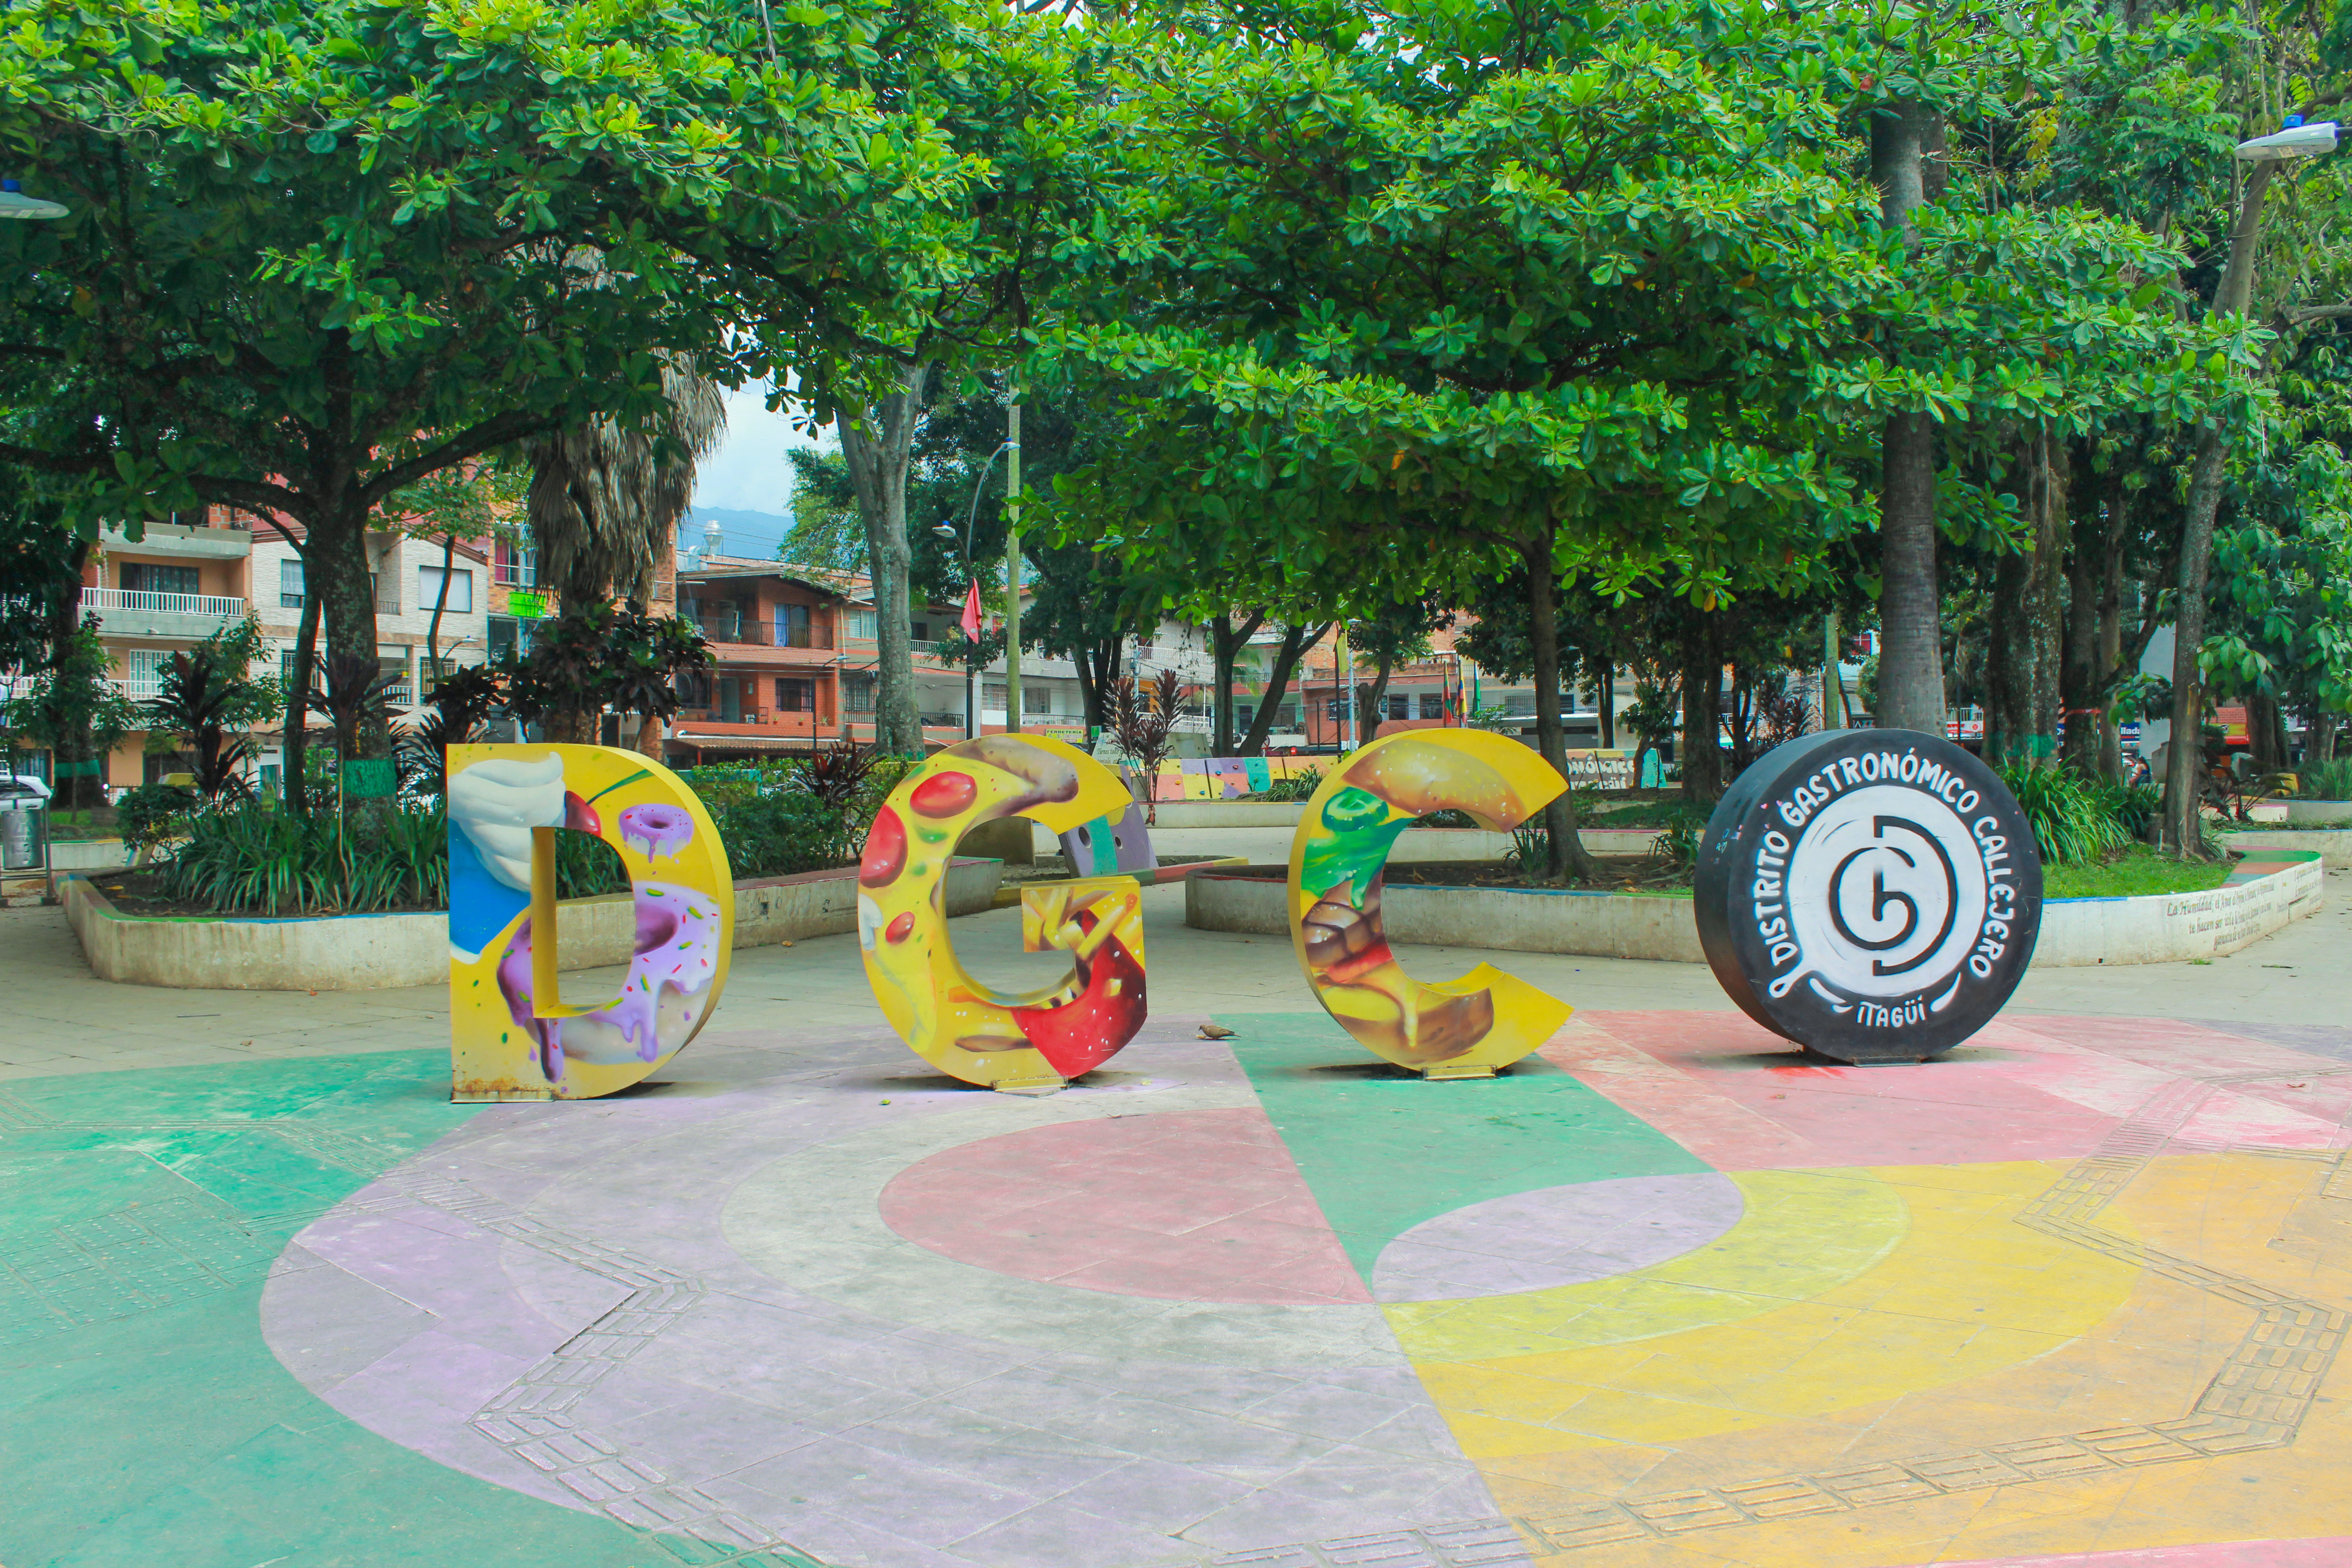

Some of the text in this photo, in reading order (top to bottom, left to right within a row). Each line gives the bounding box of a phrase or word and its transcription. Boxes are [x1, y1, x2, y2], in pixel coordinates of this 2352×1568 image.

[1753, 831, 1798, 966] DISTRITO
[1779, 747, 1980, 827] GASTRONÓMICO
[1970, 816, 2015, 978] CALLEJERO
[2167, 902, 2177, 916] La
[2189, 923, 2195, 934] te
[2197, 917, 2214, 933] hacen
